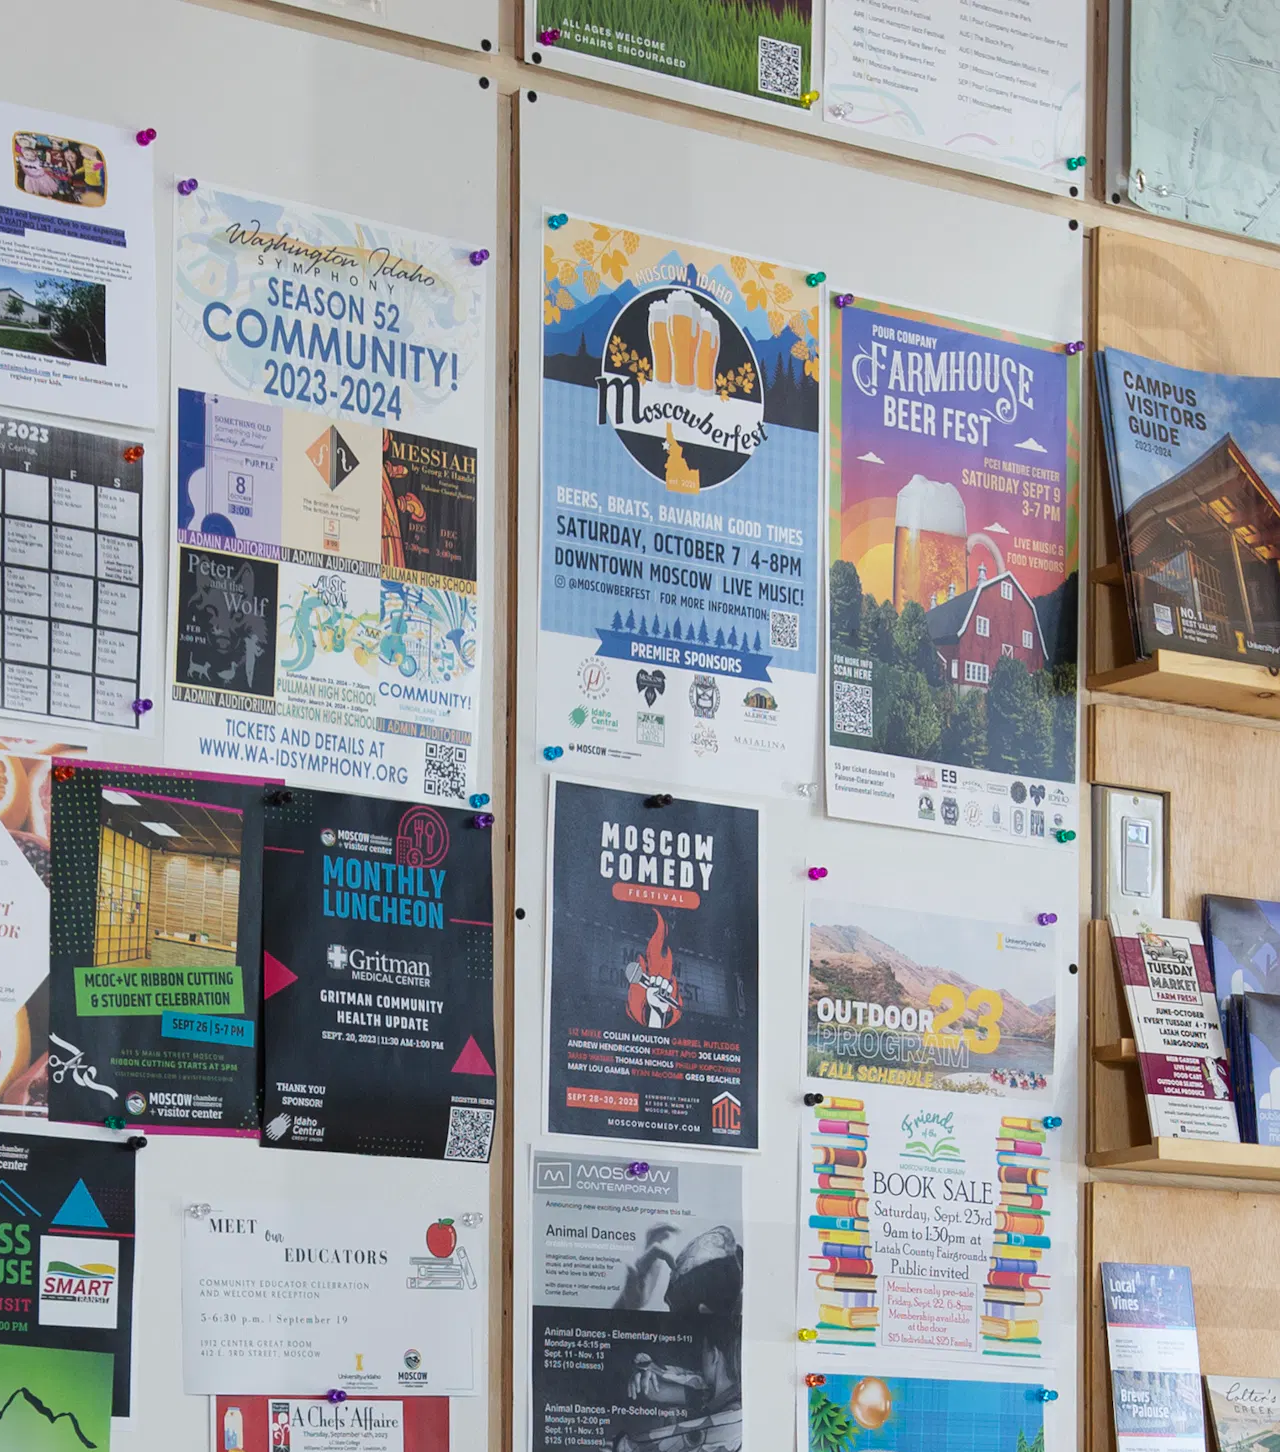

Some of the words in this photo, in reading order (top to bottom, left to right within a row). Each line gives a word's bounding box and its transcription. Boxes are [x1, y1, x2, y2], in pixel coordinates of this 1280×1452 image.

[562, 18, 581, 31] ALL
[584, 21, 611, 38] AGES
[614, 31, 666, 51] WELCOME
[226, 220, 359, 273] Washington
[368, 247, 435, 286] Idaho
[258, 254, 395, 294] SYMPHONY
[268, 276, 364, 325] SEASON
[373, 301, 400, 334] 52
[202, 301, 458, 392] COMMUNITY!
[872, 324, 895, 340] POUR
[897, 331, 937, 350] COMPANY
[264, 358, 402, 420] 2023-2024
[852, 341, 1034, 425] FARMHOUSE
[1123, 370, 1198, 407] CAMPUS
[594, 375, 769, 452] Moscowberfest
[884, 395, 936, 437] BEER
[943, 408, 991, 446] FEST
[1125, 392, 1207, 432] VISITORS
[8, 423, 49, 443] 2023
[1128, 416, 1181, 447] GUIDE
[962, 468, 1019, 493] SATURDAY
[1023, 480, 1050, 500] SEPT
[1053, 487, 1060, 503] 9
[557, 486, 602, 513] BEERS,
[608, 495, 653, 522] BRATS,
[659, 505, 723, 531] BAVARIAN
[728, 518, 761, 538] GOOD
[767, 524, 803, 546] TIMES
[1022, 500, 1041, 518] 3-7
[1044, 505, 1060, 521] PM
[557, 515, 646, 554] SATURDAY,
[654, 532, 725, 565] OCTOBER
[732, 546, 740, 565] 7
[751, 550, 801, 577] 4-8PM
[631, 641, 680, 663] PREMIER
[684, 650, 742, 673] SPONSORS
[225, 719, 276, 742] TICKETS
[280, 727, 311, 748] AND
[315, 731, 365, 755] DETAILS
[369, 741, 385, 757] AT
[200, 737, 408, 785] WWW.WA-IDSYMPHONY.ORG
[601, 820, 713, 862] MOSCOW
[323, 854, 446, 899] MONTHLY
[600, 850, 714, 891] COMEDY
[323, 888, 444, 929] LUNCHEON
[349, 948, 431, 977] Gritman
[351, 970, 394, 984] MEDICAL
[395, 973, 430, 987] CENTER
[1147, 961, 1194, 977] TUESDAY
[1151, 975, 1199, 992] MARKET
[173, 1018, 195, 1031] SEPT
[197, 1021, 208, 1033] 26
[215, 1024, 229, 1035] 5-7
[231, 1025, 244, 1037] PM
[817, 997, 935, 1033] OUTDOOR
[819, 1062, 854, 1079] FALL
[857, 1065, 934, 1088] SCHEDULE
[608, 1118, 700, 1132] MOSCOWCOMEDY.COM
[576, 1181, 671, 1195] CONTEMPORARY
[873, 1171, 936, 1200] BOOK
[943, 1178, 993, 1205] SALE
[209, 1219, 258, 1234] MEET
[546, 1224, 588, 1238] Animal
[592, 1226, 636, 1241] Dances
[284, 1248, 388, 1264] EDUCATORS
[43, 1277, 113, 1296] SMART
[1109, 1279, 1135, 1294] Local
[1111, 1297, 1139, 1312] Vines
[291, 1407, 305, 1426] A
[307, 1406, 348, 1430] Chefs'
[351, 1405, 399, 1430] Affaire
